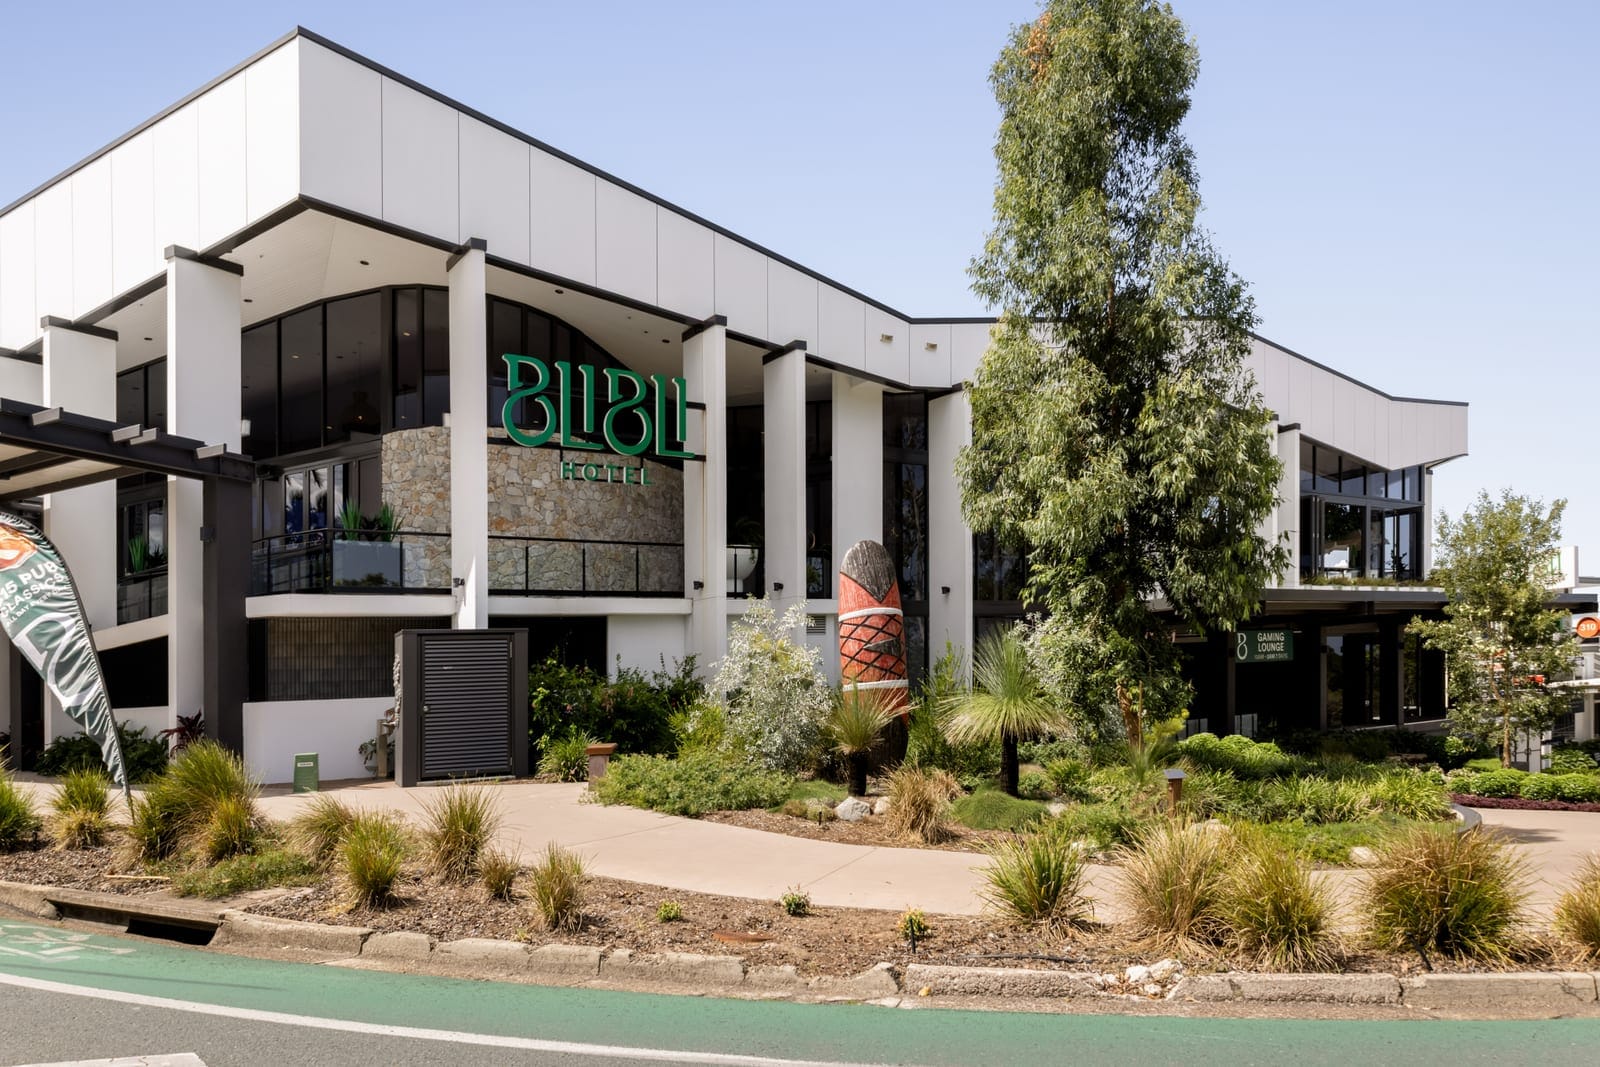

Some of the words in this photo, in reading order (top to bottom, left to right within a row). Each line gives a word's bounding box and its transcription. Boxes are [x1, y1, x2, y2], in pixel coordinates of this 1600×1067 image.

[561, 462, 655, 485] HOTEL
[18, 561, 58, 585] PUB
[0, 573, 64, 618] CLASSICS
[16, 604, 30, 617] DAY
[1257, 632, 1285, 642] GAMING
[1257, 642, 1285, 652] LOUNGE
